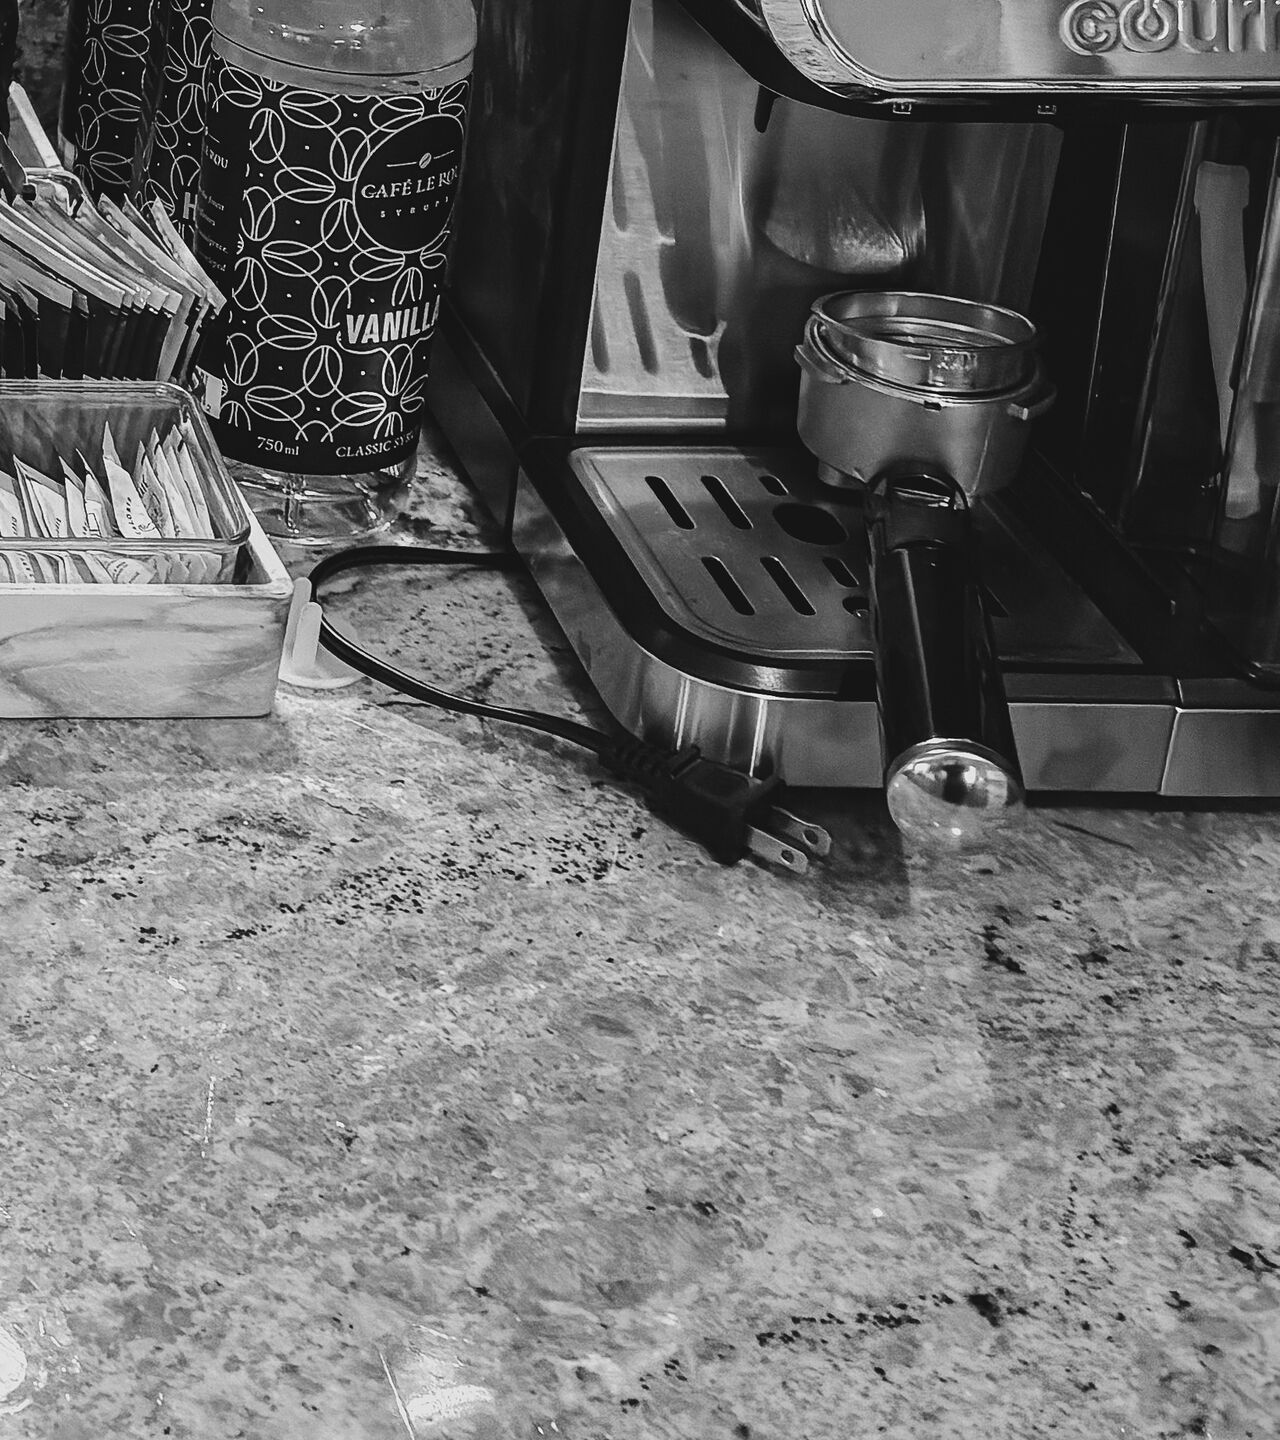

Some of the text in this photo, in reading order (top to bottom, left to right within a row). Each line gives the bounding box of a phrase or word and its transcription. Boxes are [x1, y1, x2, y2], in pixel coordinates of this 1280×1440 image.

[361, 178, 412, 199] CAFÉ
[416, 176, 435, 194] LE
[335, 440, 391, 458] CLASSIC
